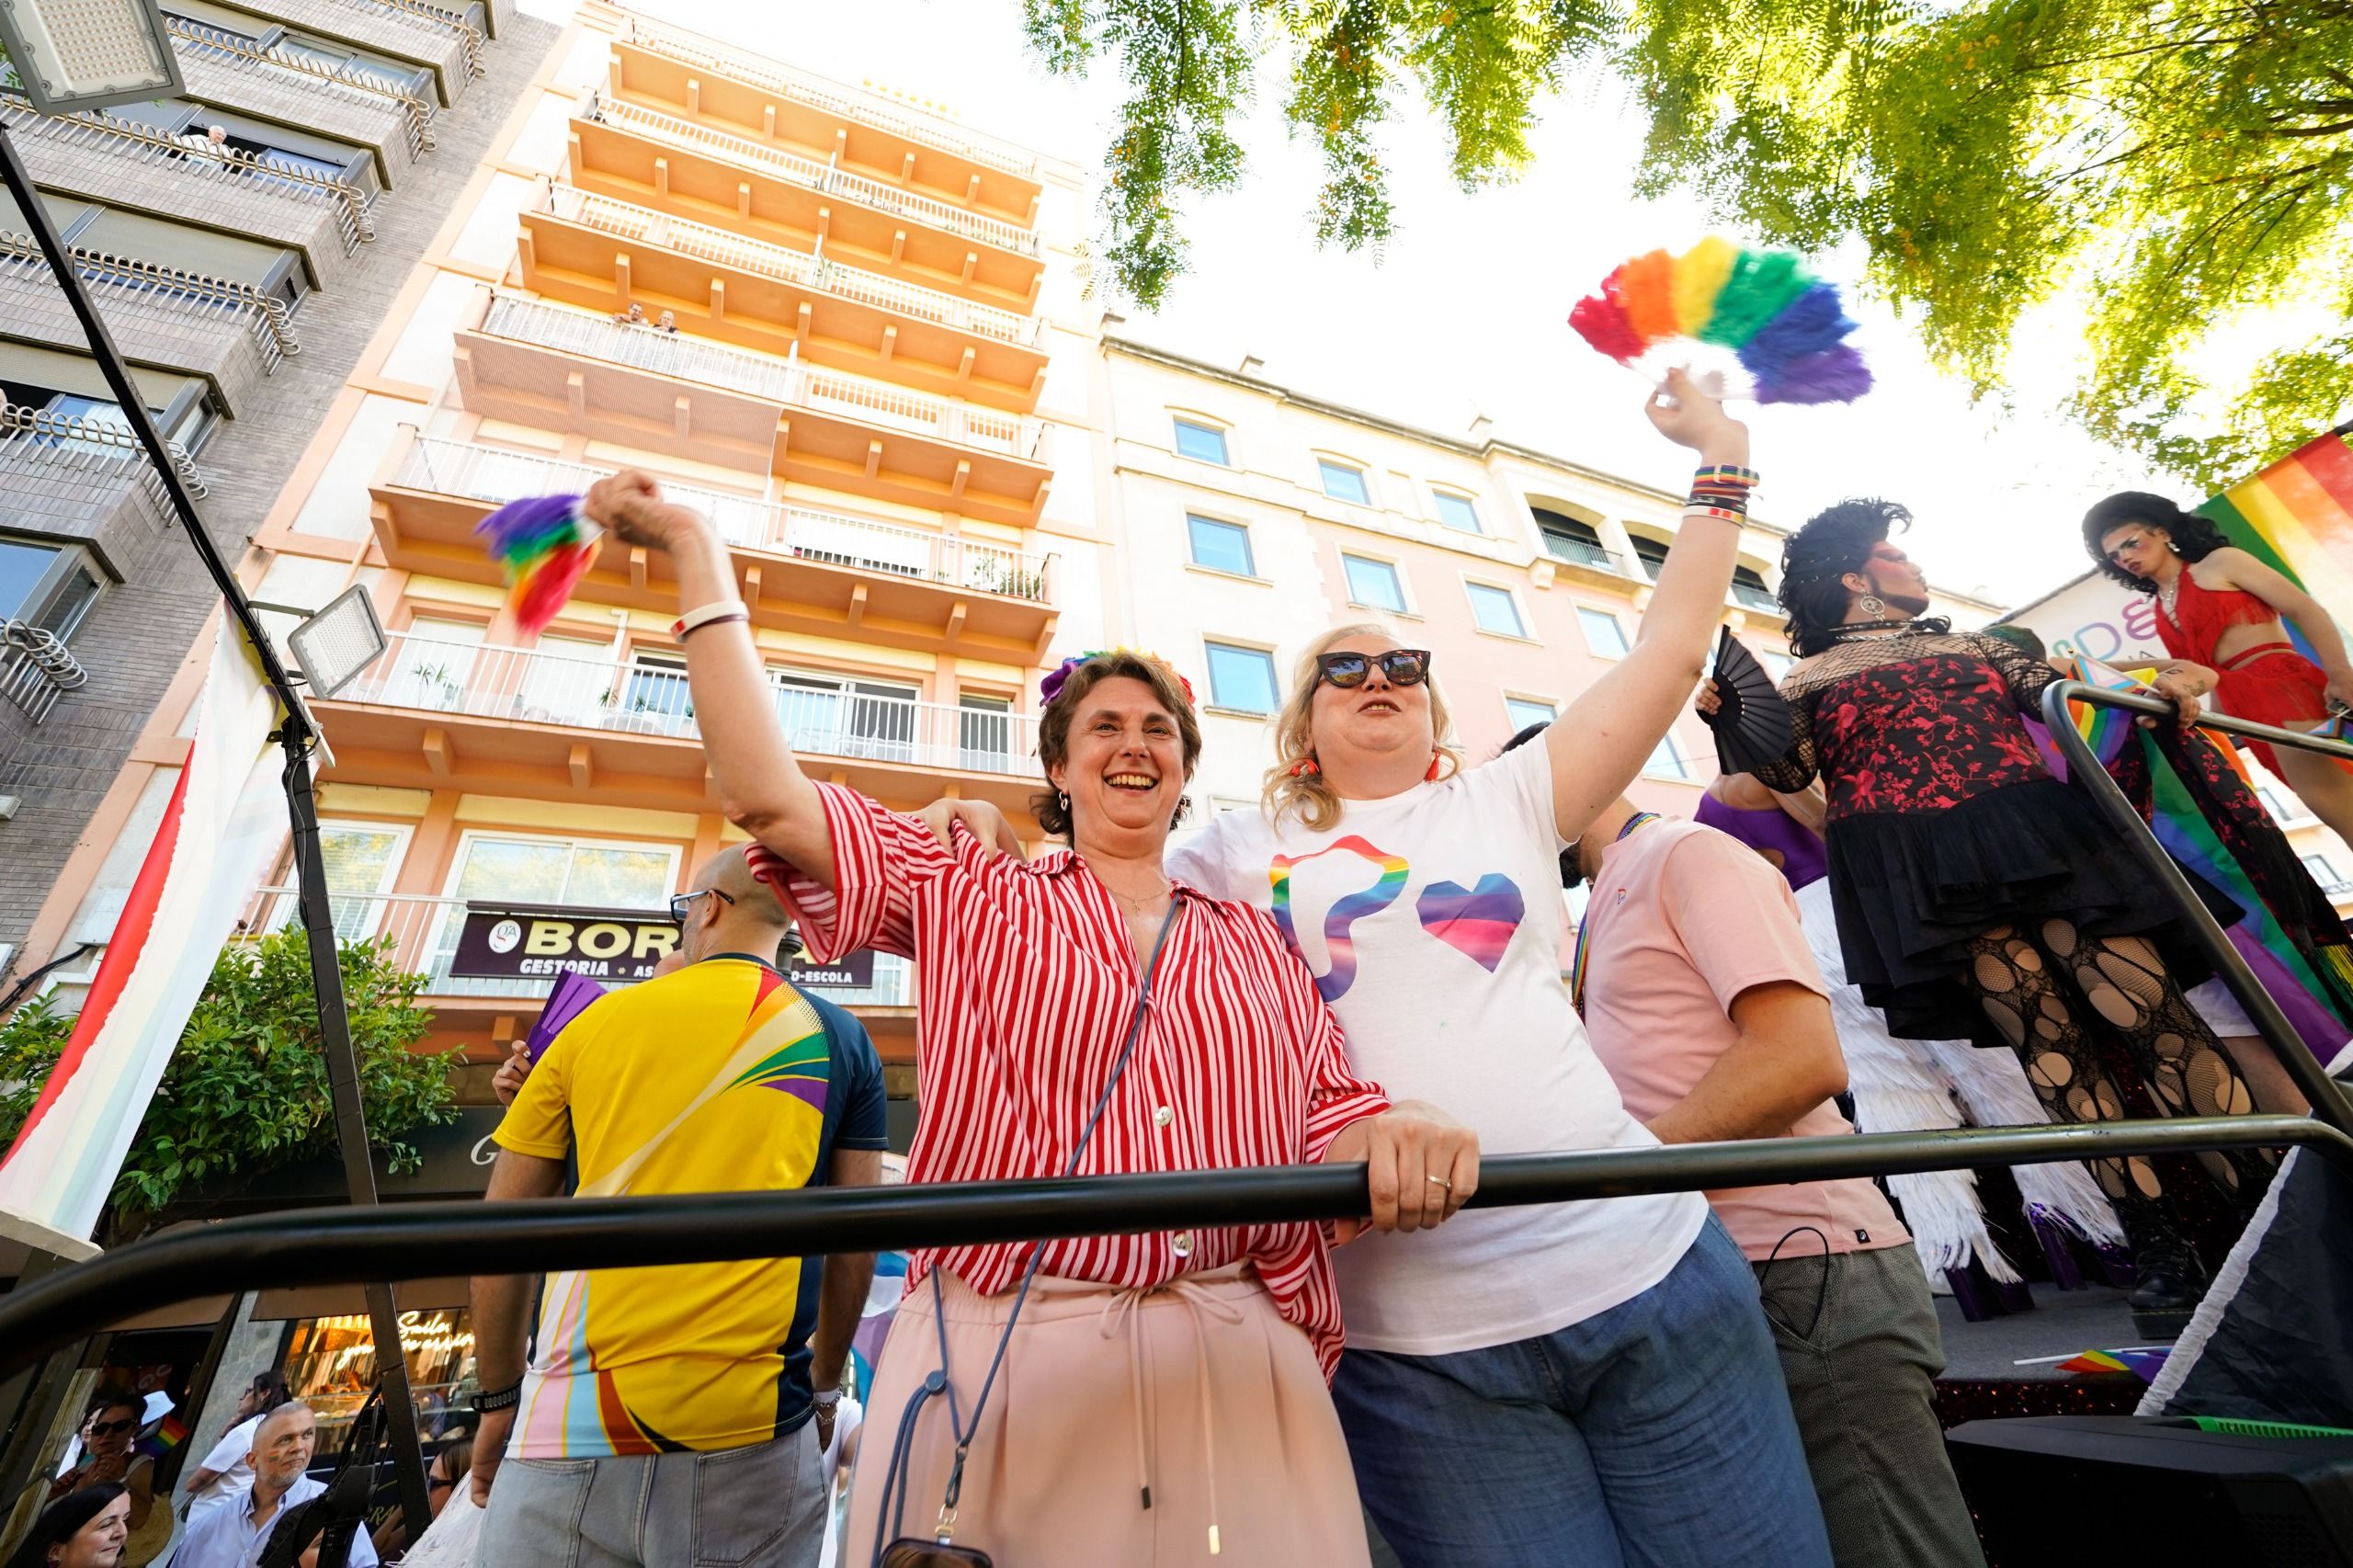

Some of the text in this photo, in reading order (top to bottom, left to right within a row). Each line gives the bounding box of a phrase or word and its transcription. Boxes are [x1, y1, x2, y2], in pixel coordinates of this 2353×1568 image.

[524, 920, 680, 959] BOR
[519, 959, 853, 983] GESTORIA AS O-ESCOLA
[470, 1133, 500, 1165] G
